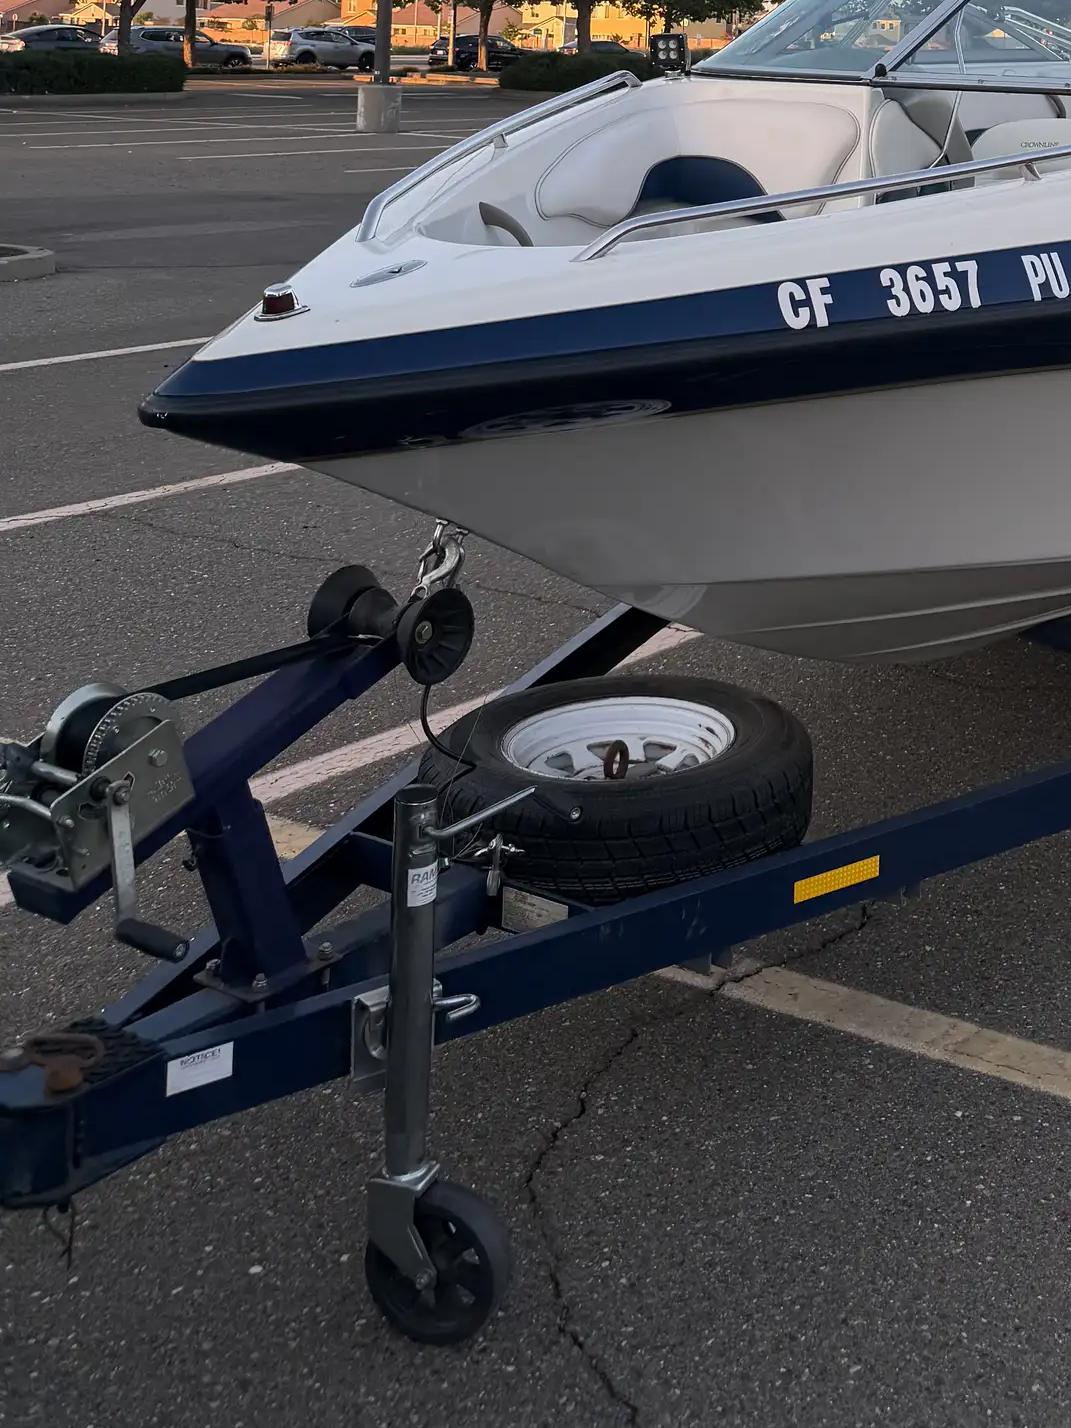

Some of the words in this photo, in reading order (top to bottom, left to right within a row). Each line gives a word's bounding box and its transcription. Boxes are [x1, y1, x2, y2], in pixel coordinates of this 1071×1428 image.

[777, 277, 834, 330] CF
[879, 260, 982, 317] 3657
[1020, 252, 1070, 302] PU
